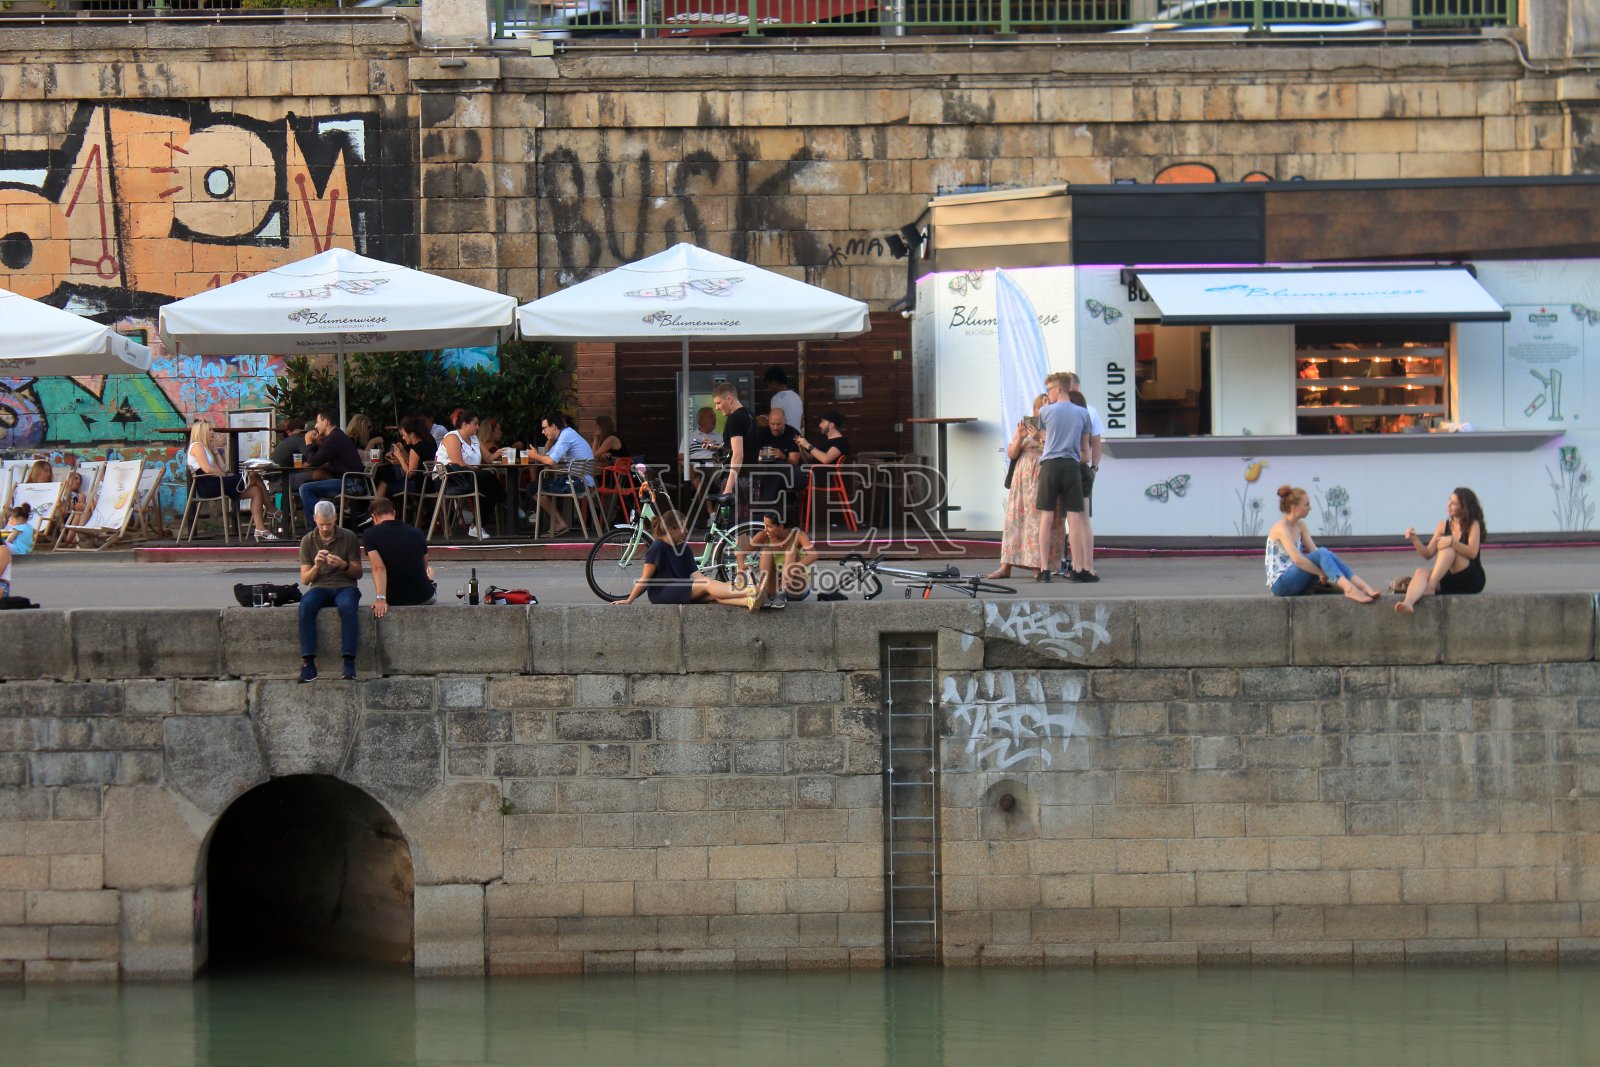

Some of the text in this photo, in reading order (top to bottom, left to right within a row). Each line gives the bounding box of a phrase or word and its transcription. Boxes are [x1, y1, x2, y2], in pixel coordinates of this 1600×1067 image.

[305, 312, 388, 325] Blumenwiese
[660, 314, 741, 327] Blumenwiese
[949, 305, 1060, 329] Blumese
[1107, 362, 1126, 429] PICK UP
